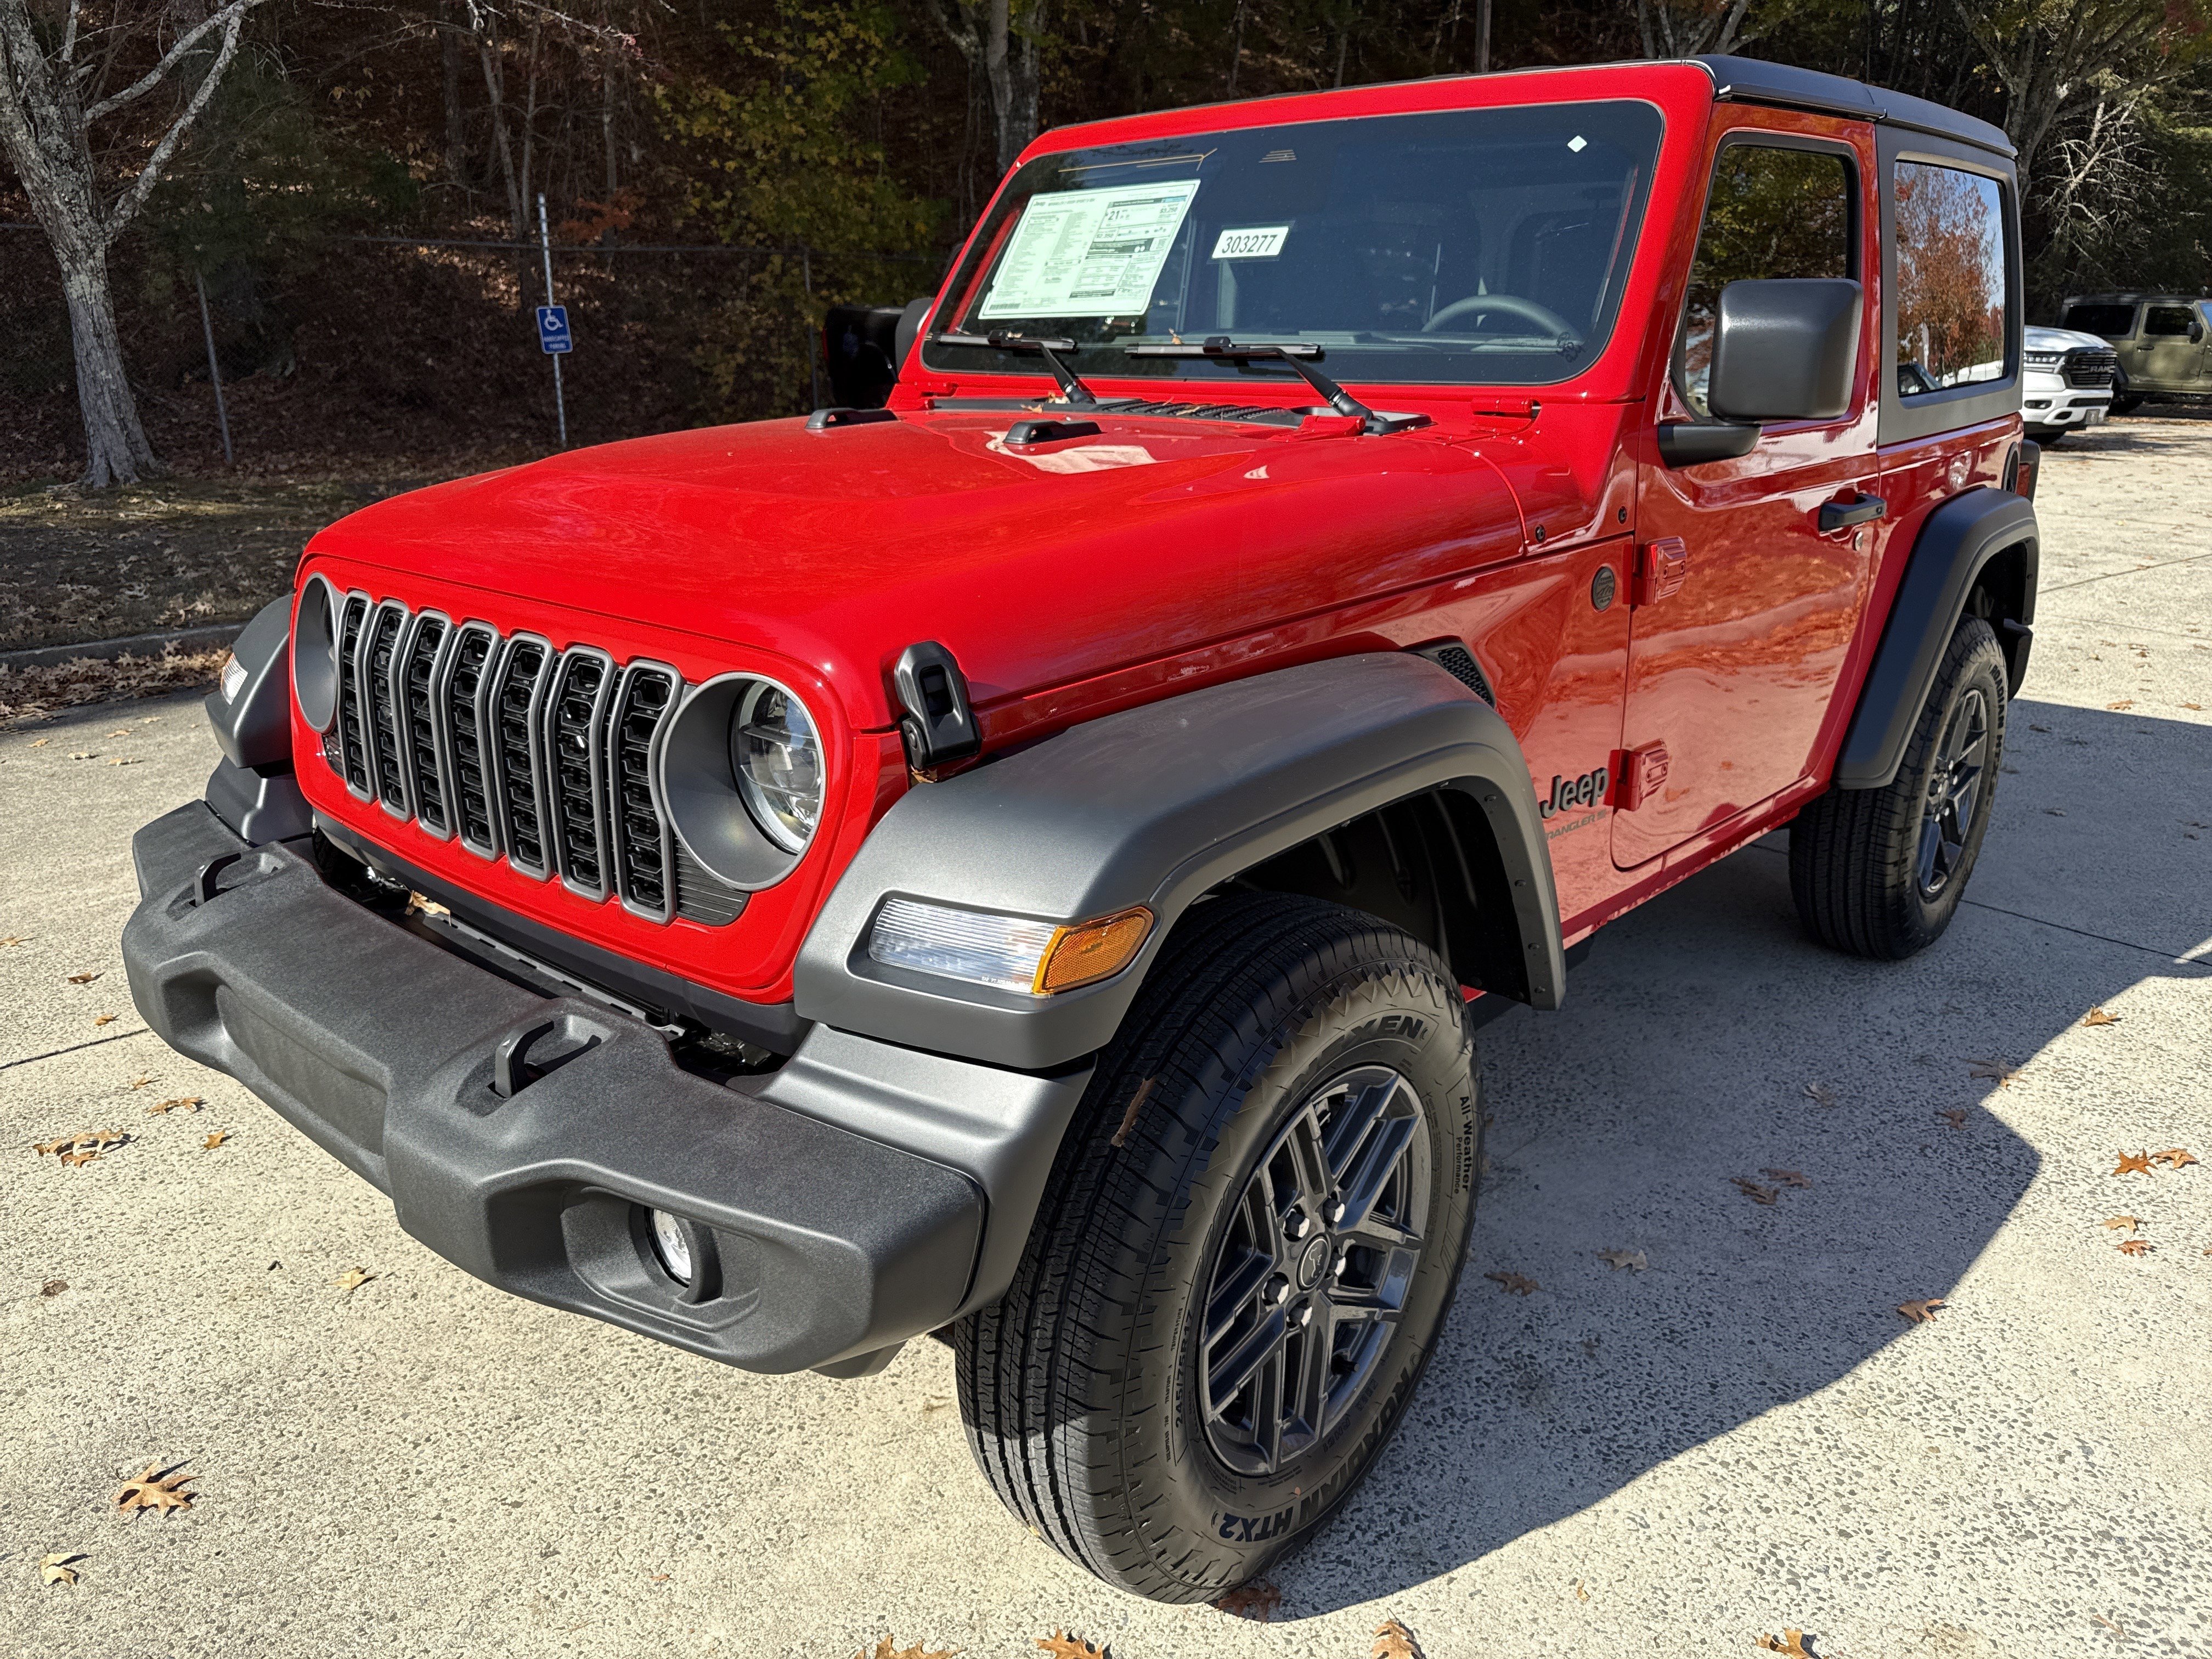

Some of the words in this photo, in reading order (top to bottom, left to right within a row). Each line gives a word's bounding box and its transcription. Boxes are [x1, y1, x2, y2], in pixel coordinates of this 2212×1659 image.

[1107, 210, 1120, 221] 21
[1222, 234, 1278, 254] 303277
[1989, 664, 2005, 730] ROADIAN
[1539, 767, 1609, 819] Jeep
[1546, 814, 1595, 839] RANGLER
[1453, 1136, 1463, 1195] Performance
[1459, 1096, 1474, 1192] All-Weather
[1298, 1367, 1414, 1525] ROADIAN
[1218, 1505, 1294, 1543] HTX2
